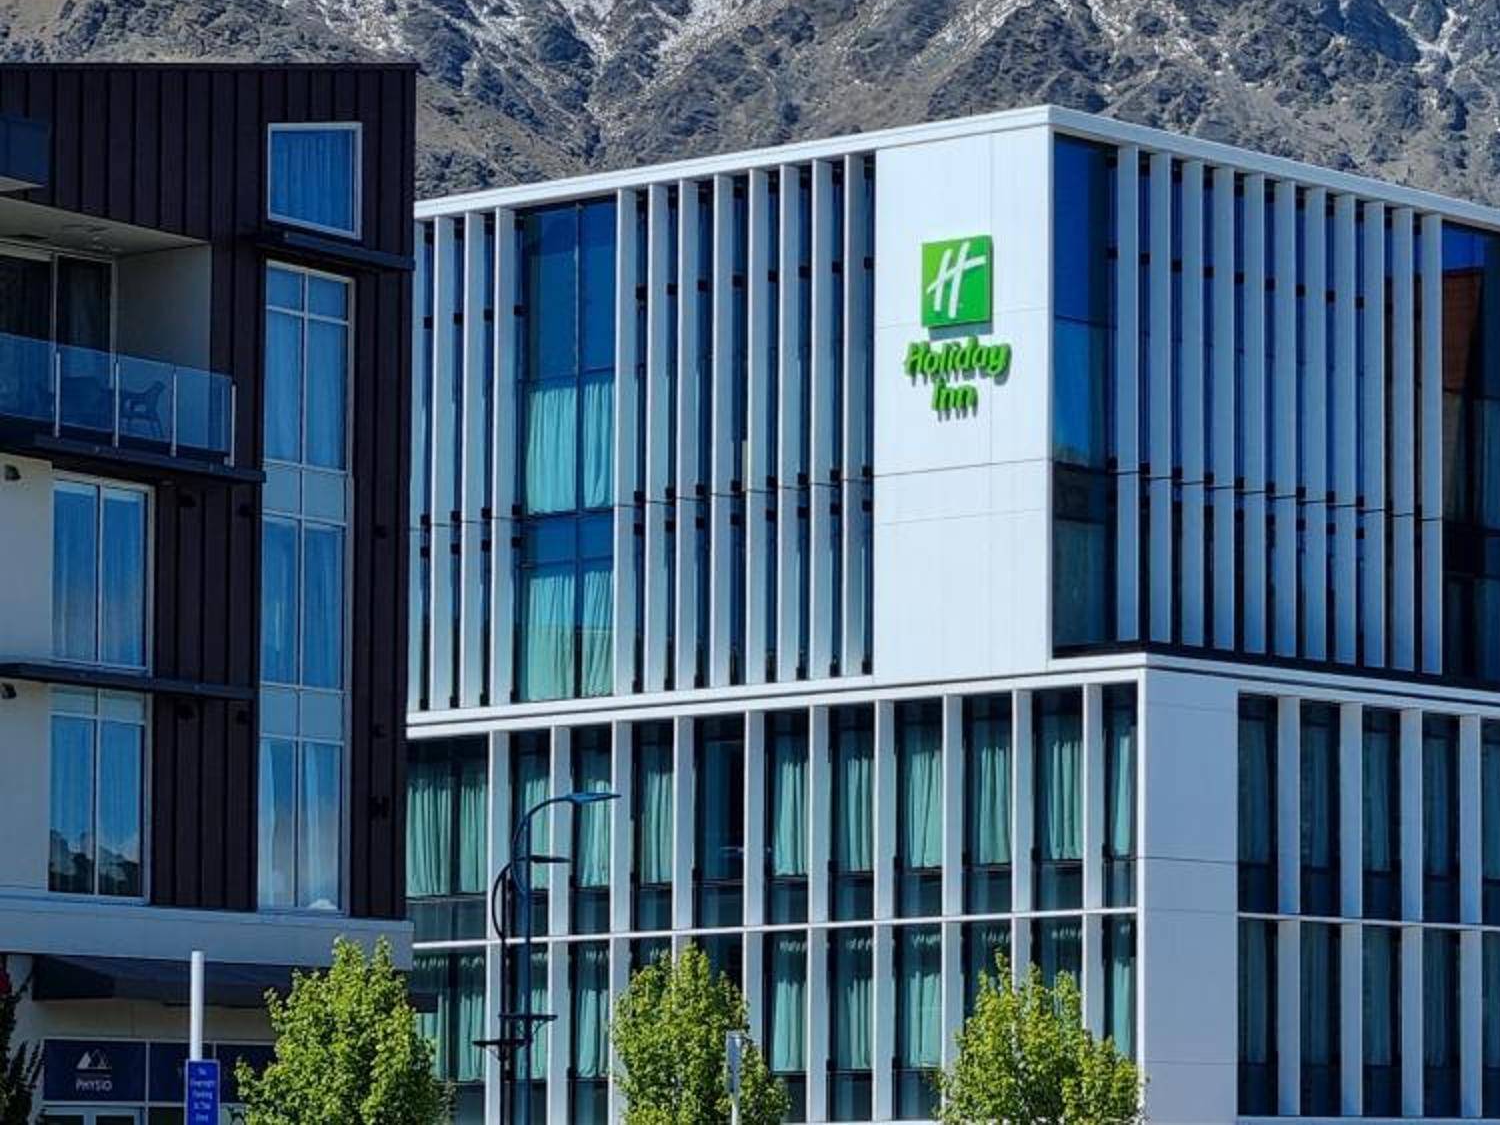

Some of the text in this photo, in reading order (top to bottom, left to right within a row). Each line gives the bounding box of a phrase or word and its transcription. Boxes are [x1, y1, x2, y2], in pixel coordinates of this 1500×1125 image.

[905, 336, 1012, 377] Holiday
[931, 379, 978, 412] Inn
[75, 1078, 113, 1092] PHYSIO
